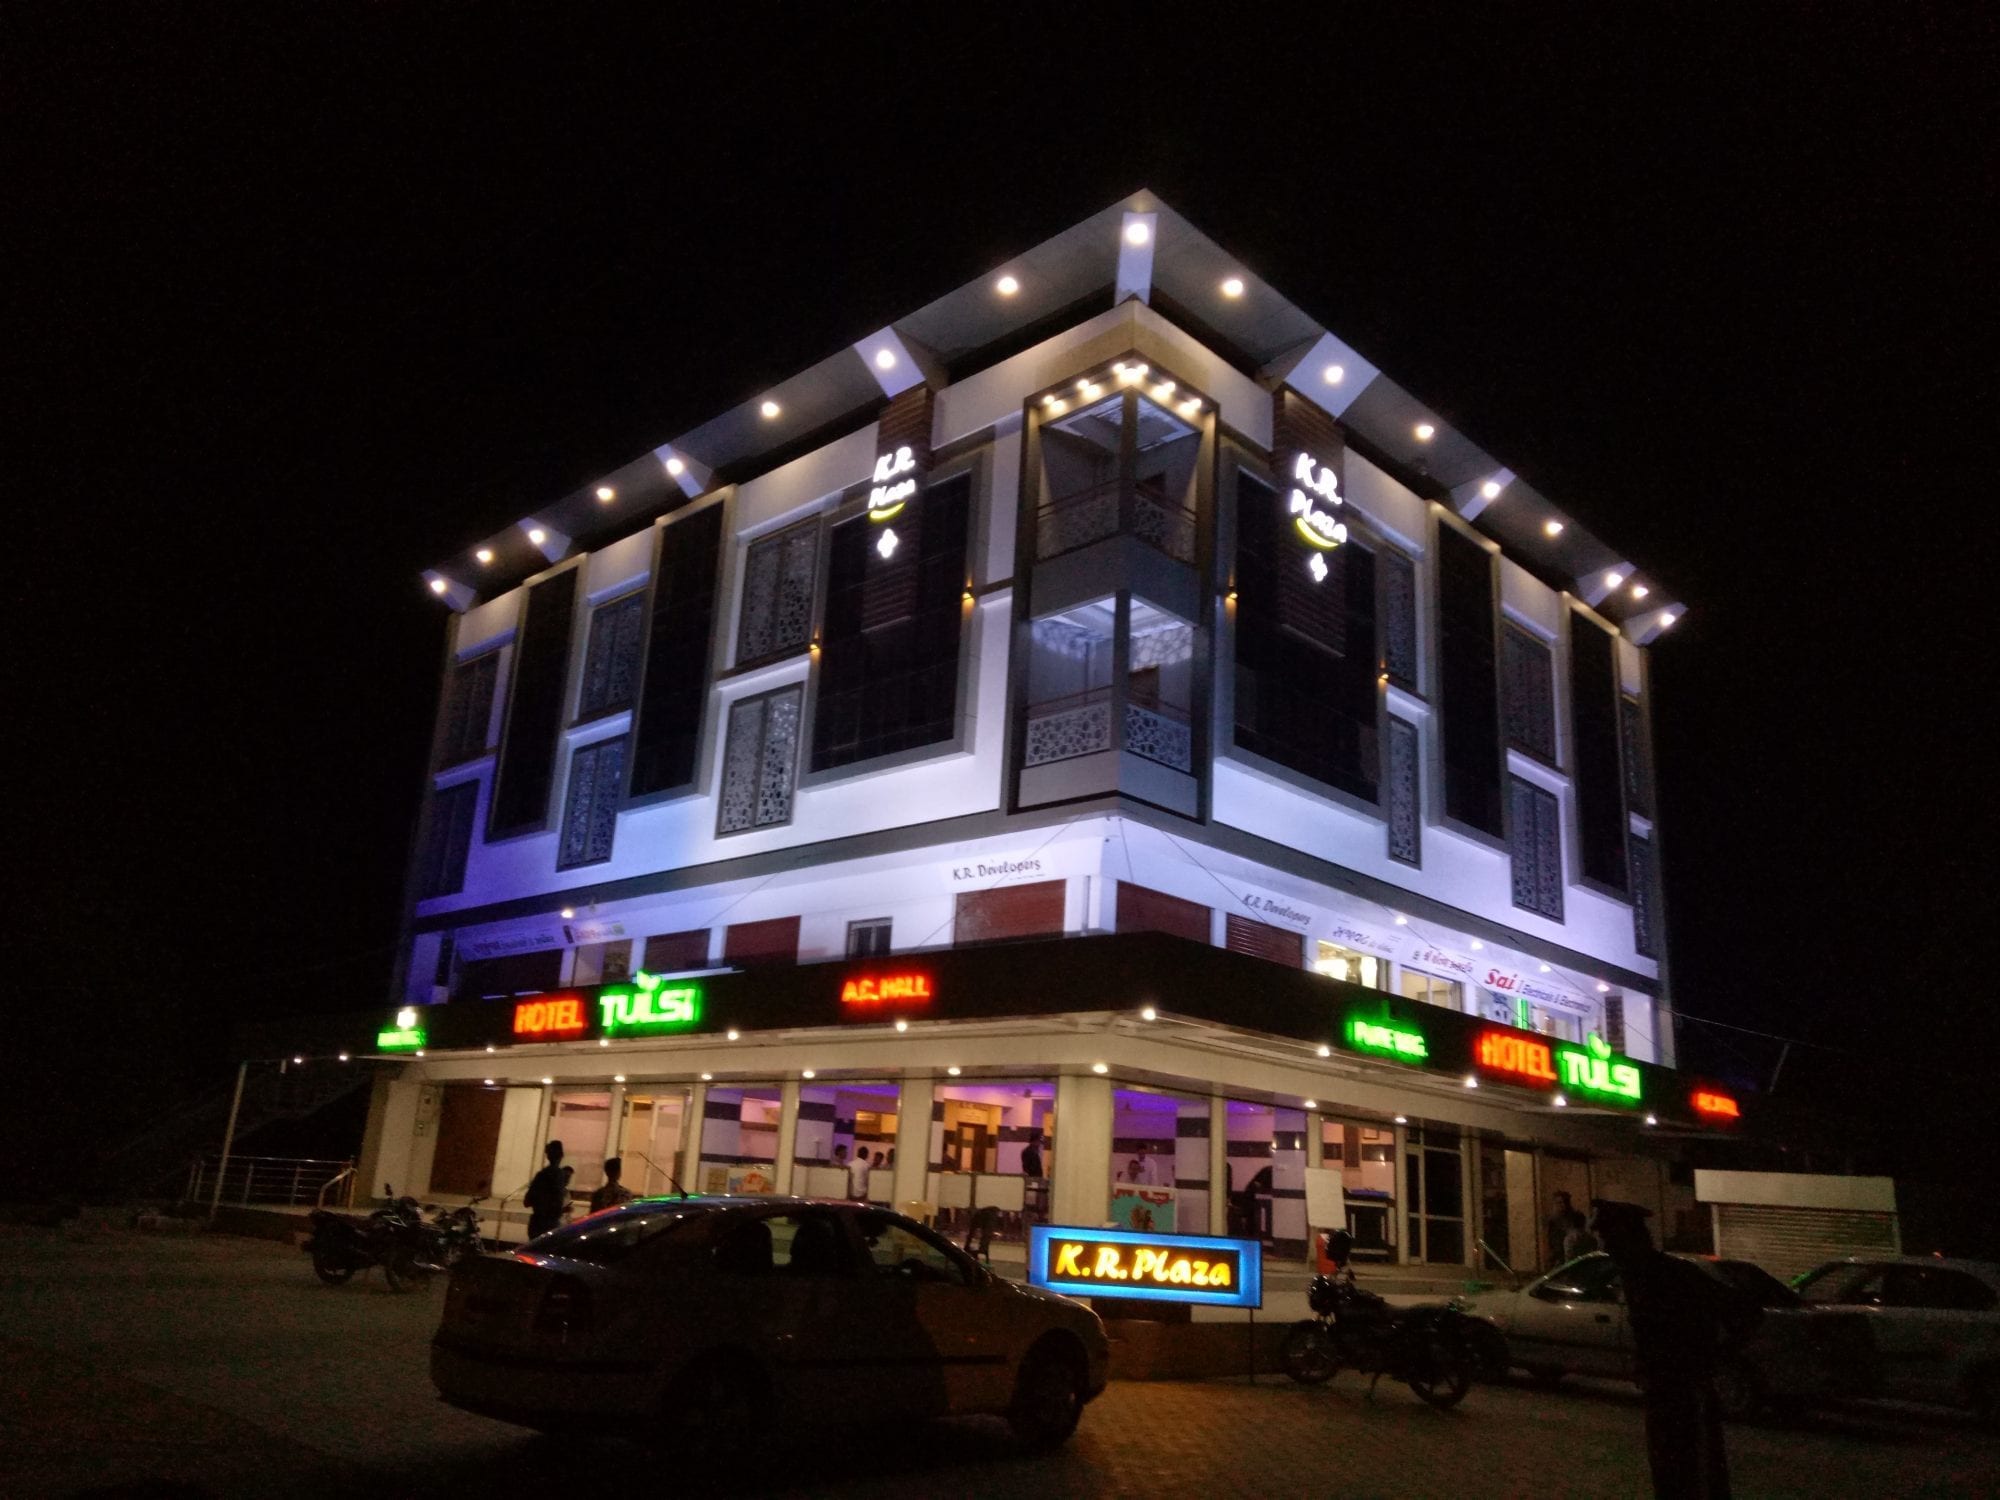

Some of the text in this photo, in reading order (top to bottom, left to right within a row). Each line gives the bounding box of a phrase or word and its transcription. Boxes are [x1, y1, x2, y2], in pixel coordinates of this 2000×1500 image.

[1290, 488, 1347, 543] Plaza
[977, 859, 1041, 878] Developers
[880, 975, 931, 999] HALL
[1484, 968, 1518, 991] Sai
[513, 1000, 584, 1034] HOTEL
[599, 988, 697, 1028] TULSI
[1479, 1033, 1558, 1081] HOTEL
[1561, 1050, 1642, 1099] TULSI
[1131, 1248, 1231, 1287] Plaza
